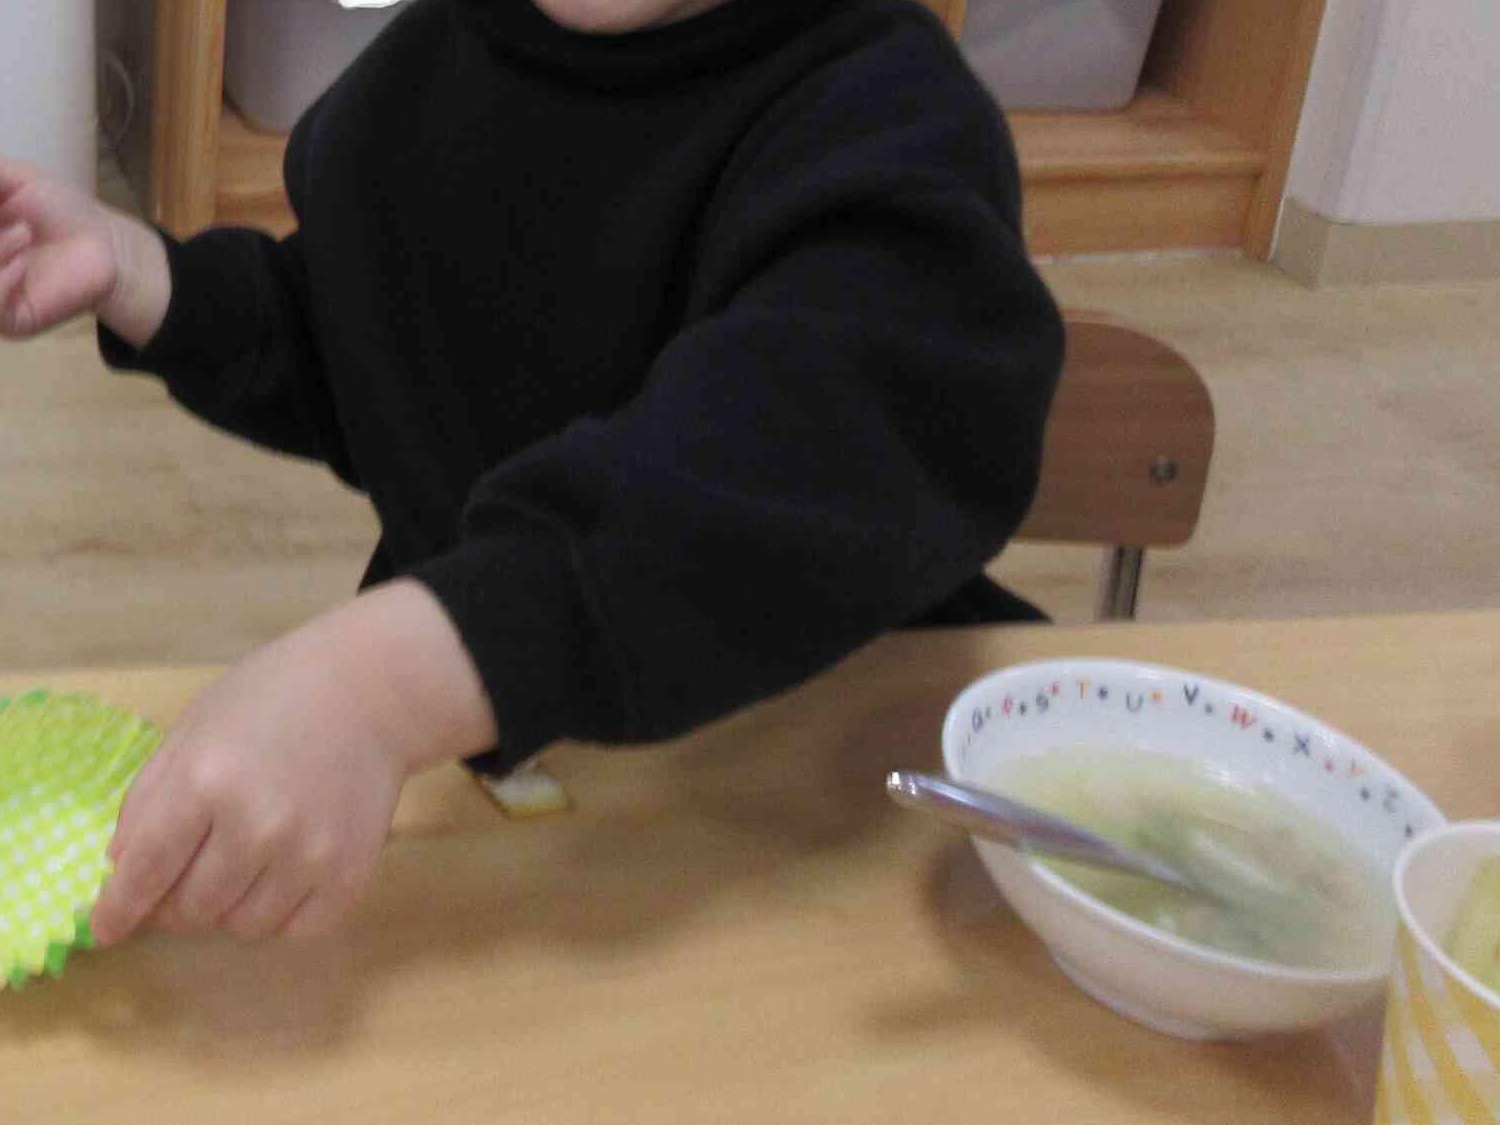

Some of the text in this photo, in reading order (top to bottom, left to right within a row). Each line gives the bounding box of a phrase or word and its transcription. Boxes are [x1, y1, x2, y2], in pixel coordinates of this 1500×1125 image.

[1125, 692, 1144, 713] U
[1183, 685, 1199, 706] V
[1294, 731, 1311, 758] X
